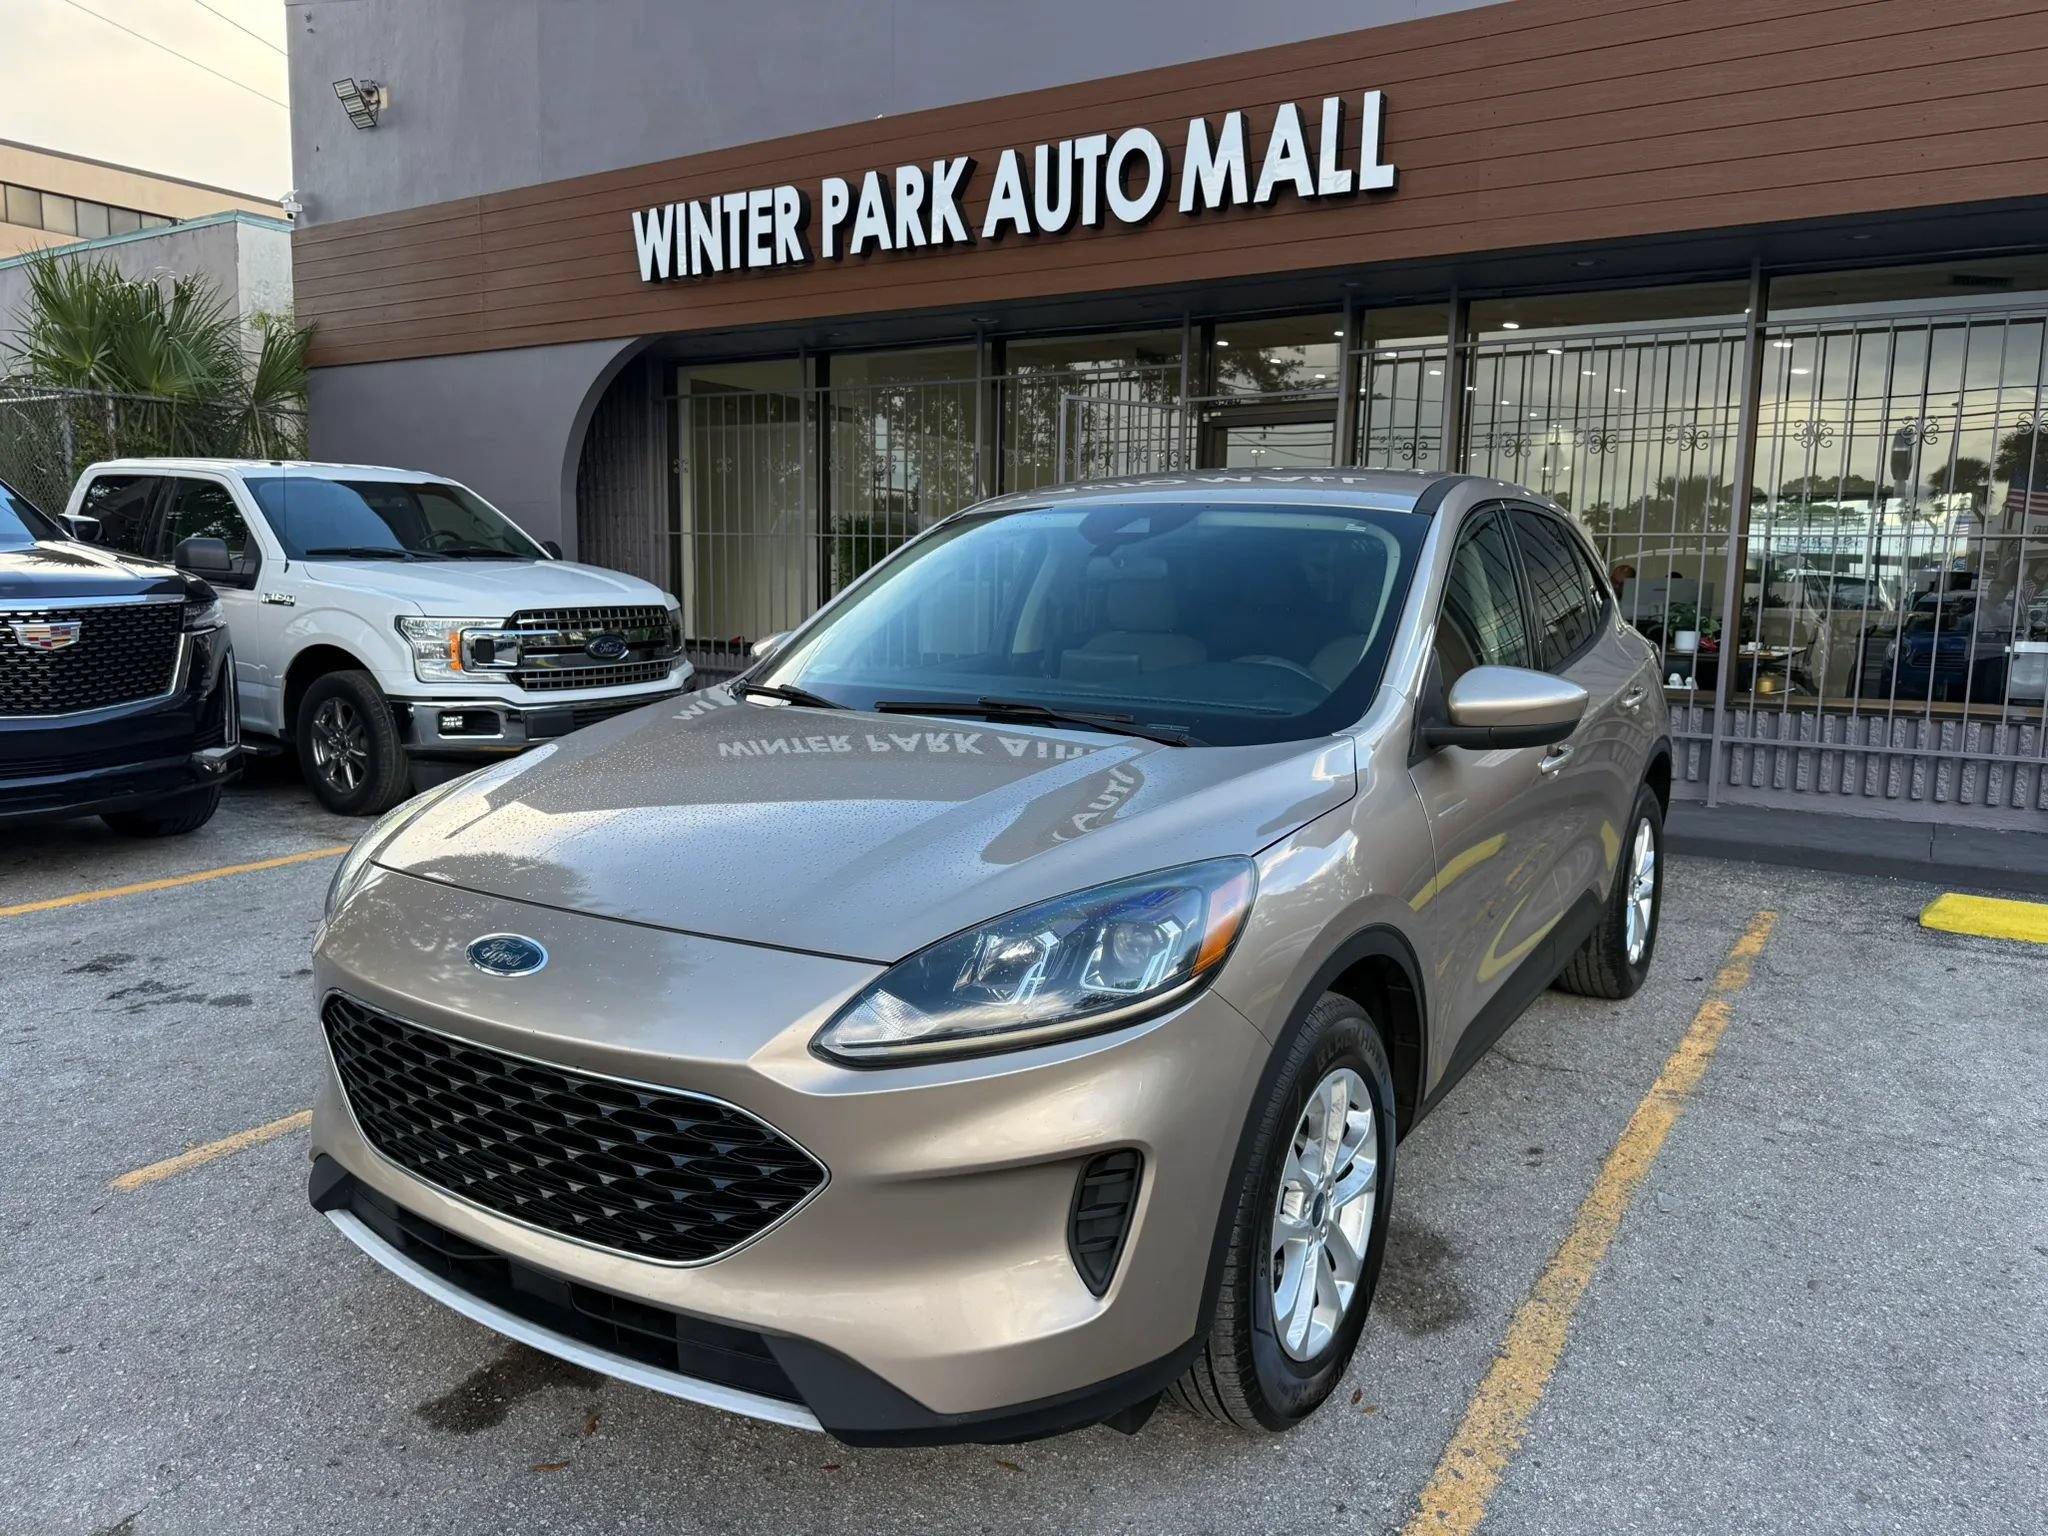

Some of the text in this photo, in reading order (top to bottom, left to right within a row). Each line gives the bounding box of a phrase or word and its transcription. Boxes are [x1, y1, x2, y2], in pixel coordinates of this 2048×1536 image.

[632, 89, 1397, 283] WINTER PARK AUTO MALL
[480, 939, 529, 967] Ford
